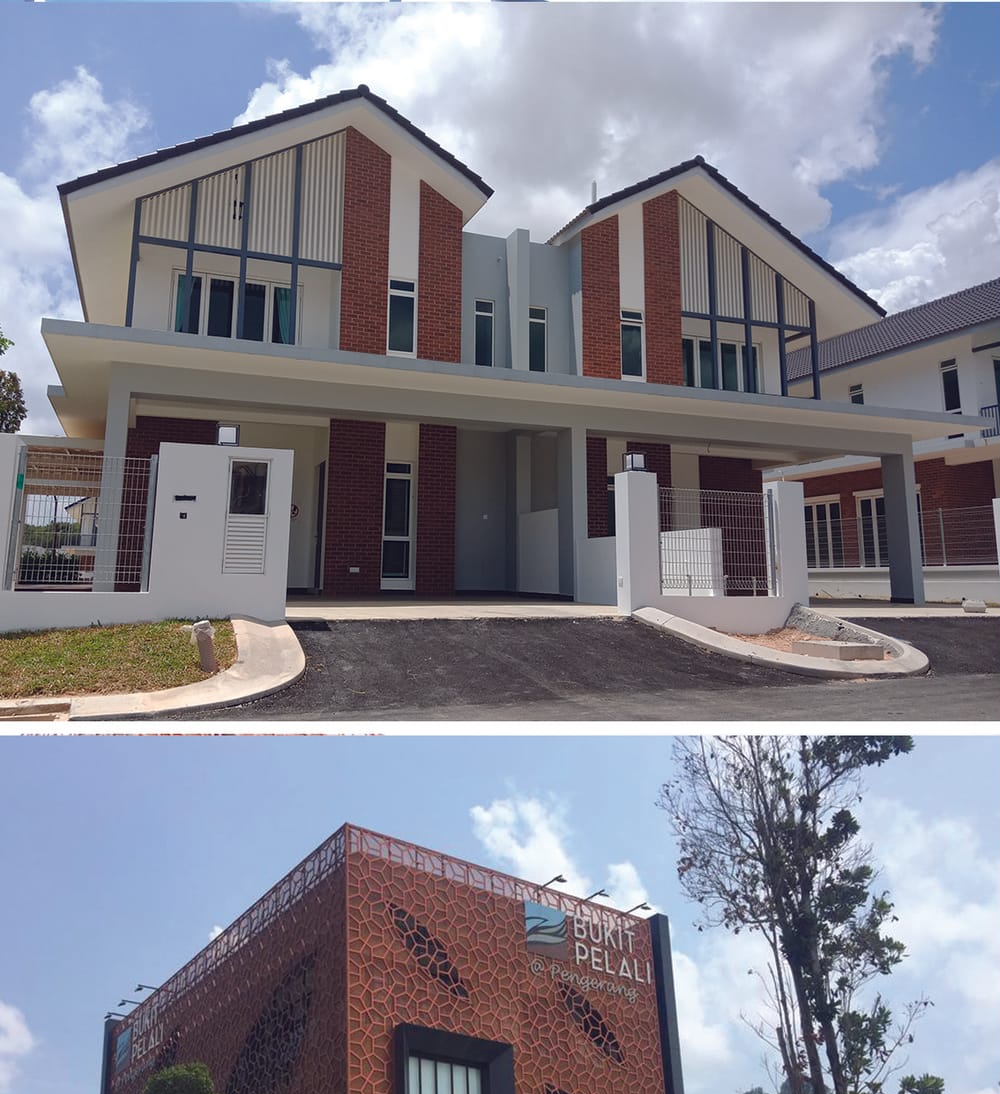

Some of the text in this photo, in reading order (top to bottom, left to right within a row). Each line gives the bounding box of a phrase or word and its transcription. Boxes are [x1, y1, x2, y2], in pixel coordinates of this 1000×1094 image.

[574, 914, 635, 953] BUKIT
[575, 941, 651, 984] PELALI
[549, 964, 640, 1004] Pengerang
